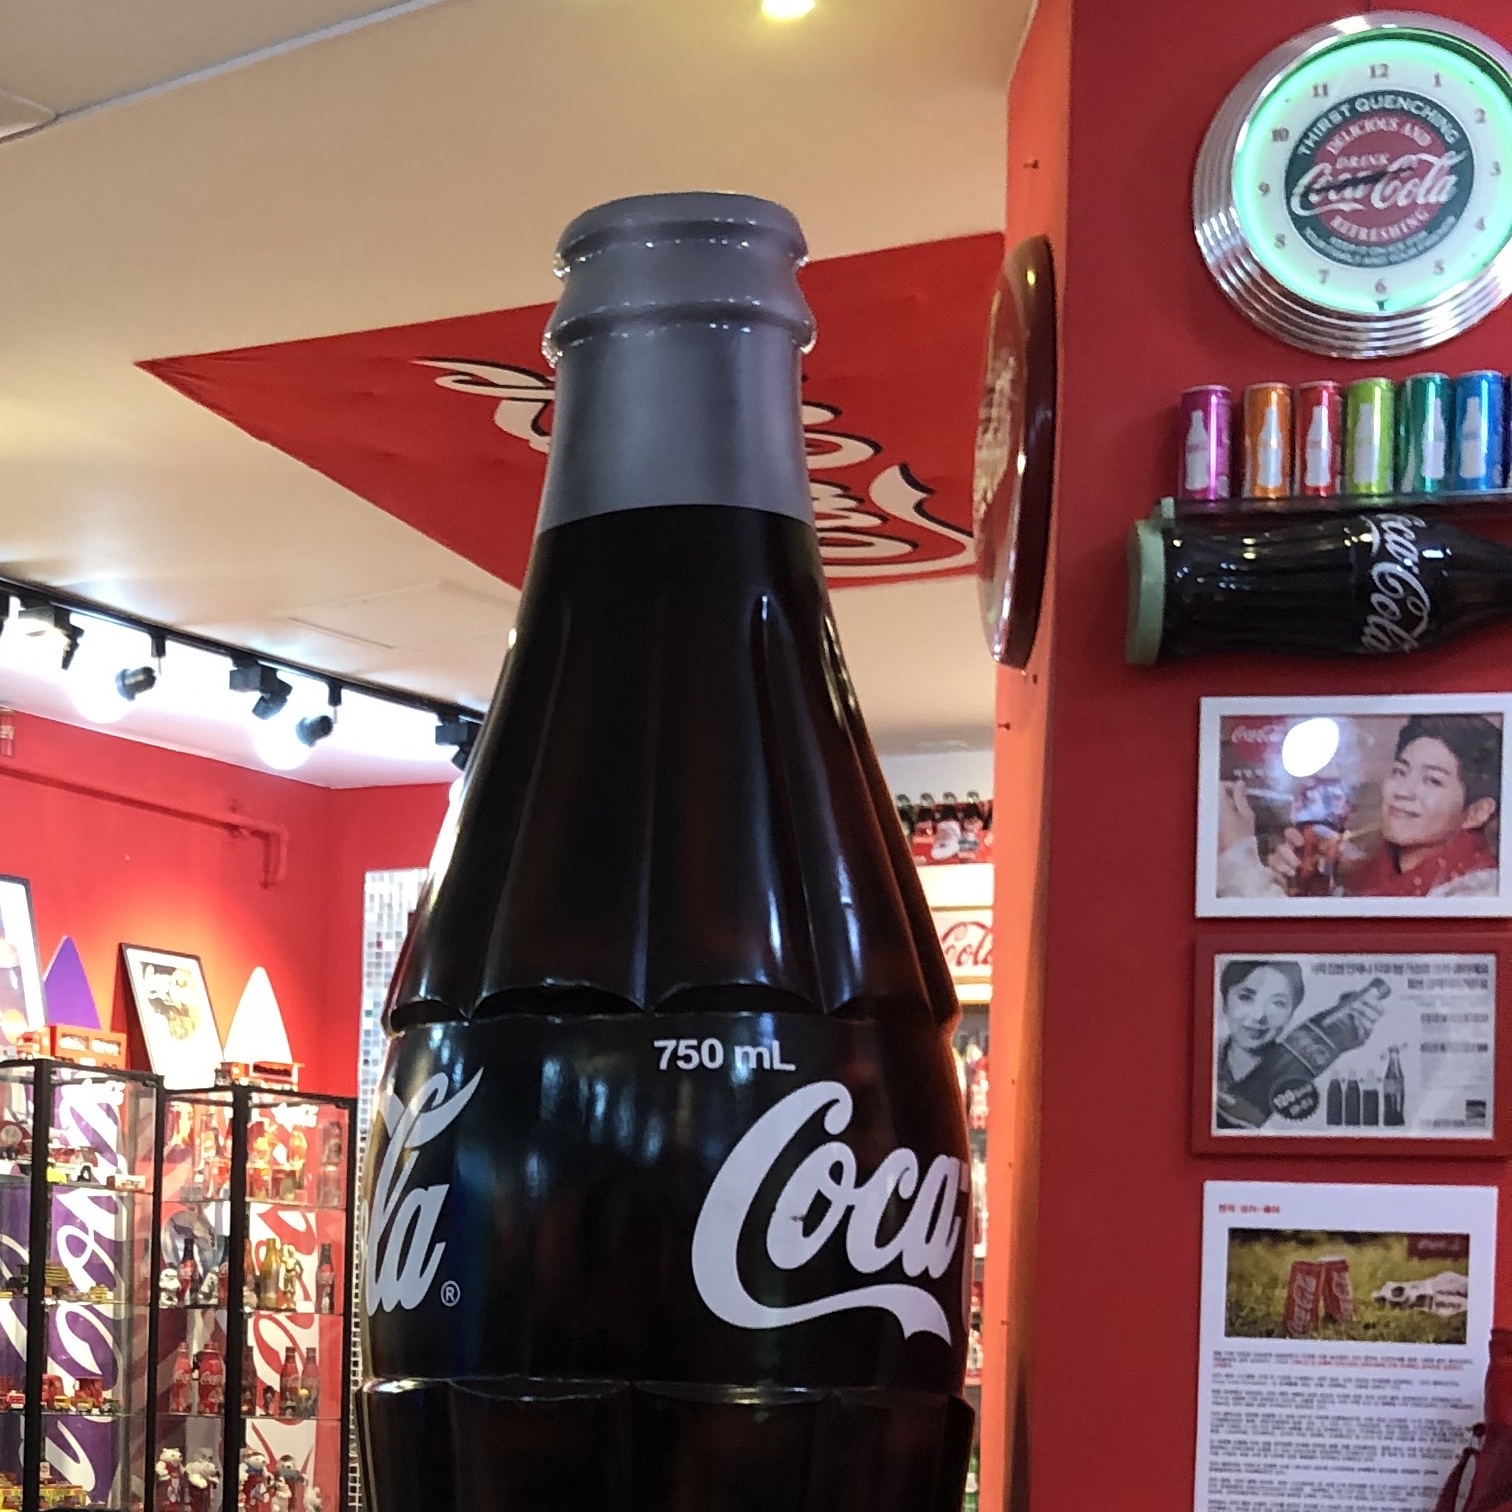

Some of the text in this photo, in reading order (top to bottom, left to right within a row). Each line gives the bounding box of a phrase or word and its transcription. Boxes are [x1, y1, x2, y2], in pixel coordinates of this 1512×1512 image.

[1369, 64, 1390, 79] 12
[1433, 73, 1442, 88] 1
[1311, 83, 1329, 97] 11
[1474, 108, 1487, 124] 2
[1297, 94, 1462, 155] THIRST QUENCHING
[1272, 128, 1290, 142] 10
[1491, 162, 1502, 176] 3
[1258, 182, 1270, 196] 9
[1475, 216, 1487, 231] 4
[1433, 260, 1444, 275] 5
[1318, 268, 1330, 284] 7
[1374, 278, 1387, 293] 6
[654, 1038, 796, 1071] 750 mL
